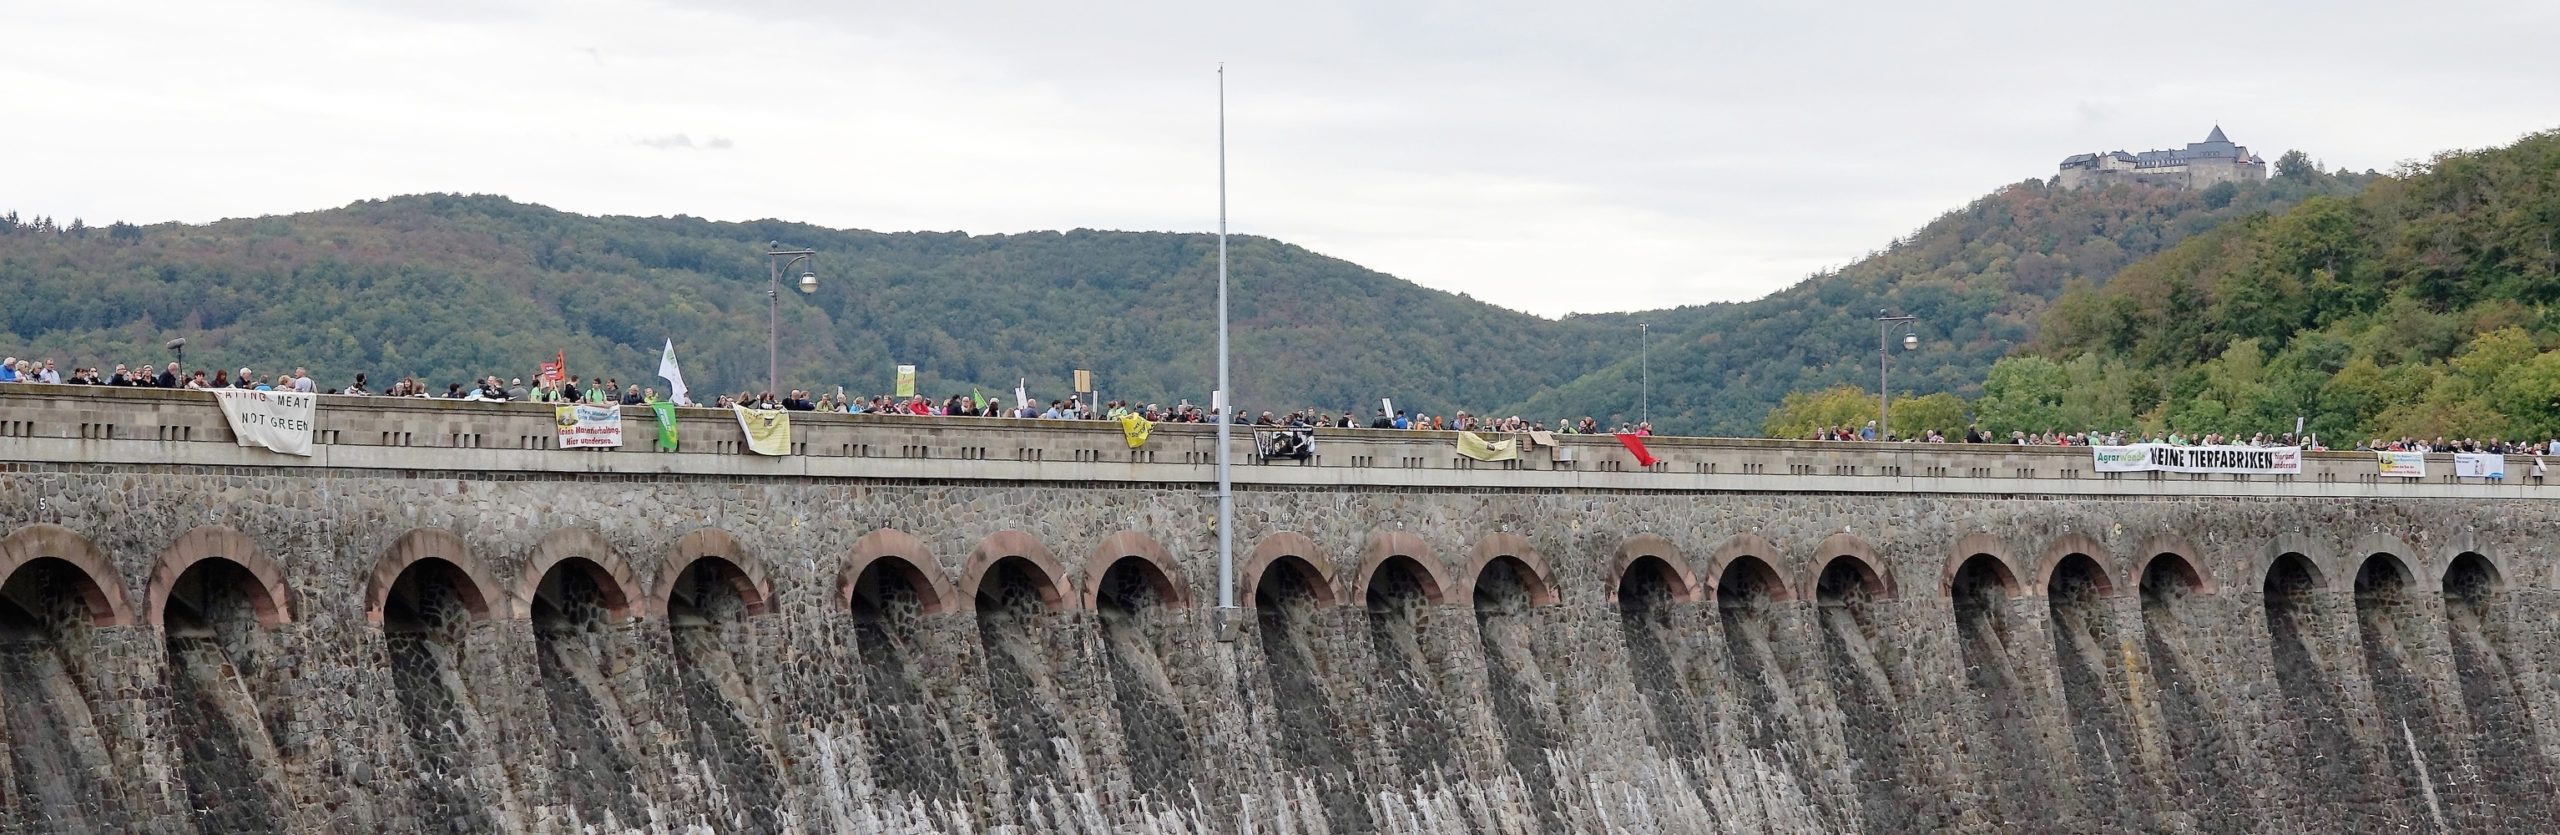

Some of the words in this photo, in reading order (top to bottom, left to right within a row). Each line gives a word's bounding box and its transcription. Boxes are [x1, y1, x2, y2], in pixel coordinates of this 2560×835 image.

[278, 395, 309, 408] MEAT
[242, 413, 265, 425] NOT
[271, 417, 309, 431] GREEN
[2189, 450, 2273, 468] TIERFABRIKEN
[40, 498, 46, 509] 5
[210, 509, 215, 521] 6
